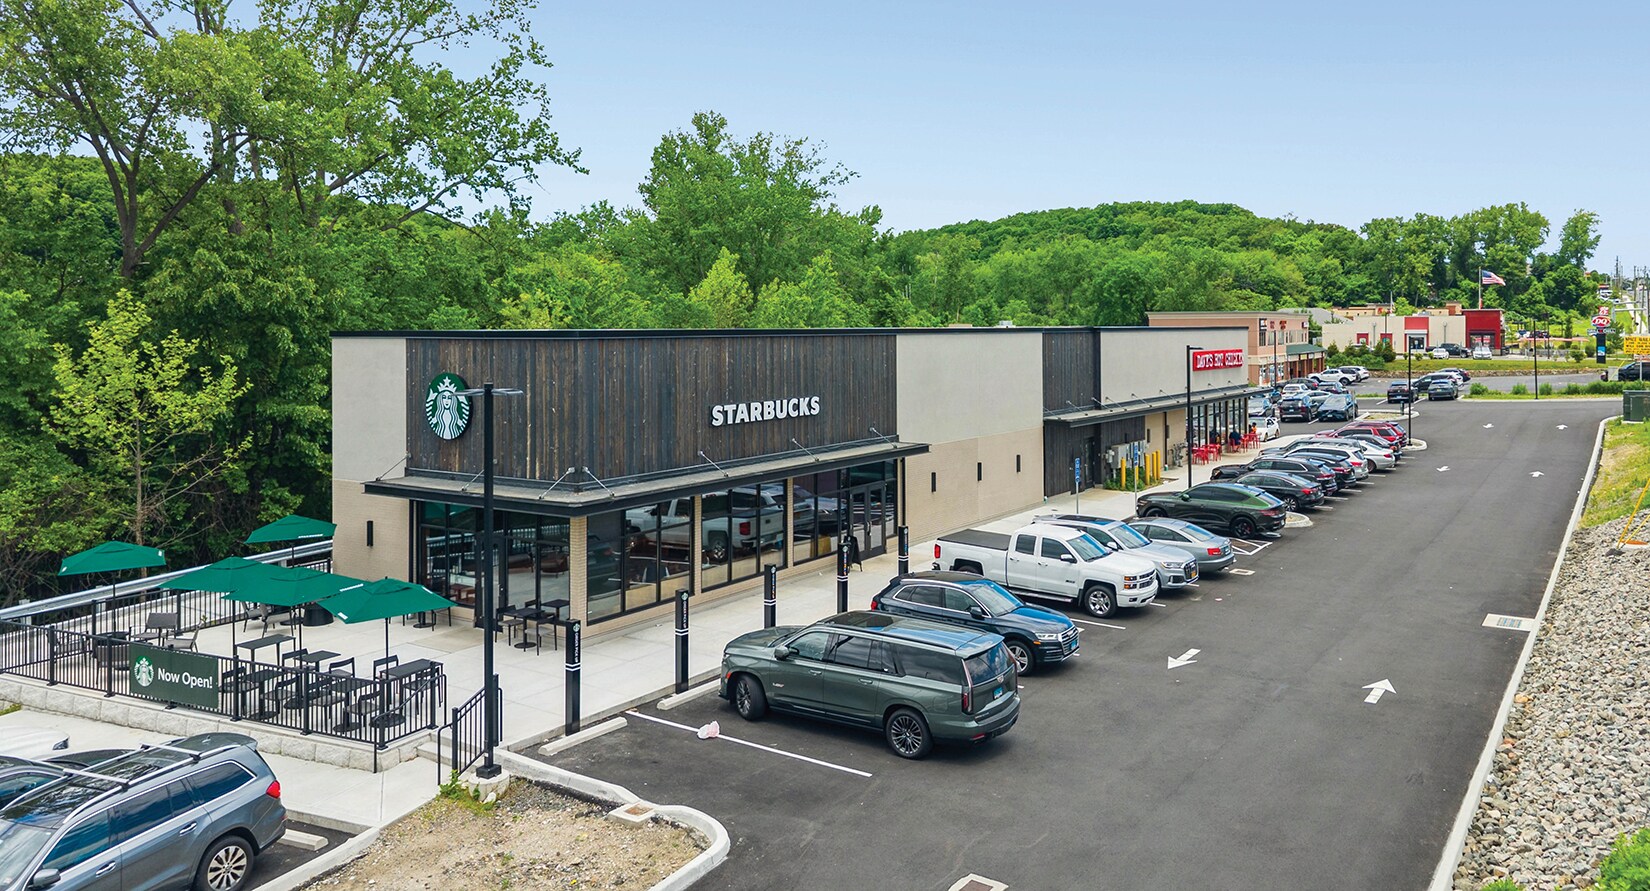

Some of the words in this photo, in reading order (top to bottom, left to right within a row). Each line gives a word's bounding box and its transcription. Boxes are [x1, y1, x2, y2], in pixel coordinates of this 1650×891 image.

[712, 396, 820, 426] STARBUCKS
[158, 667, 180, 683] Now
[182, 672, 213, 689] Open!
